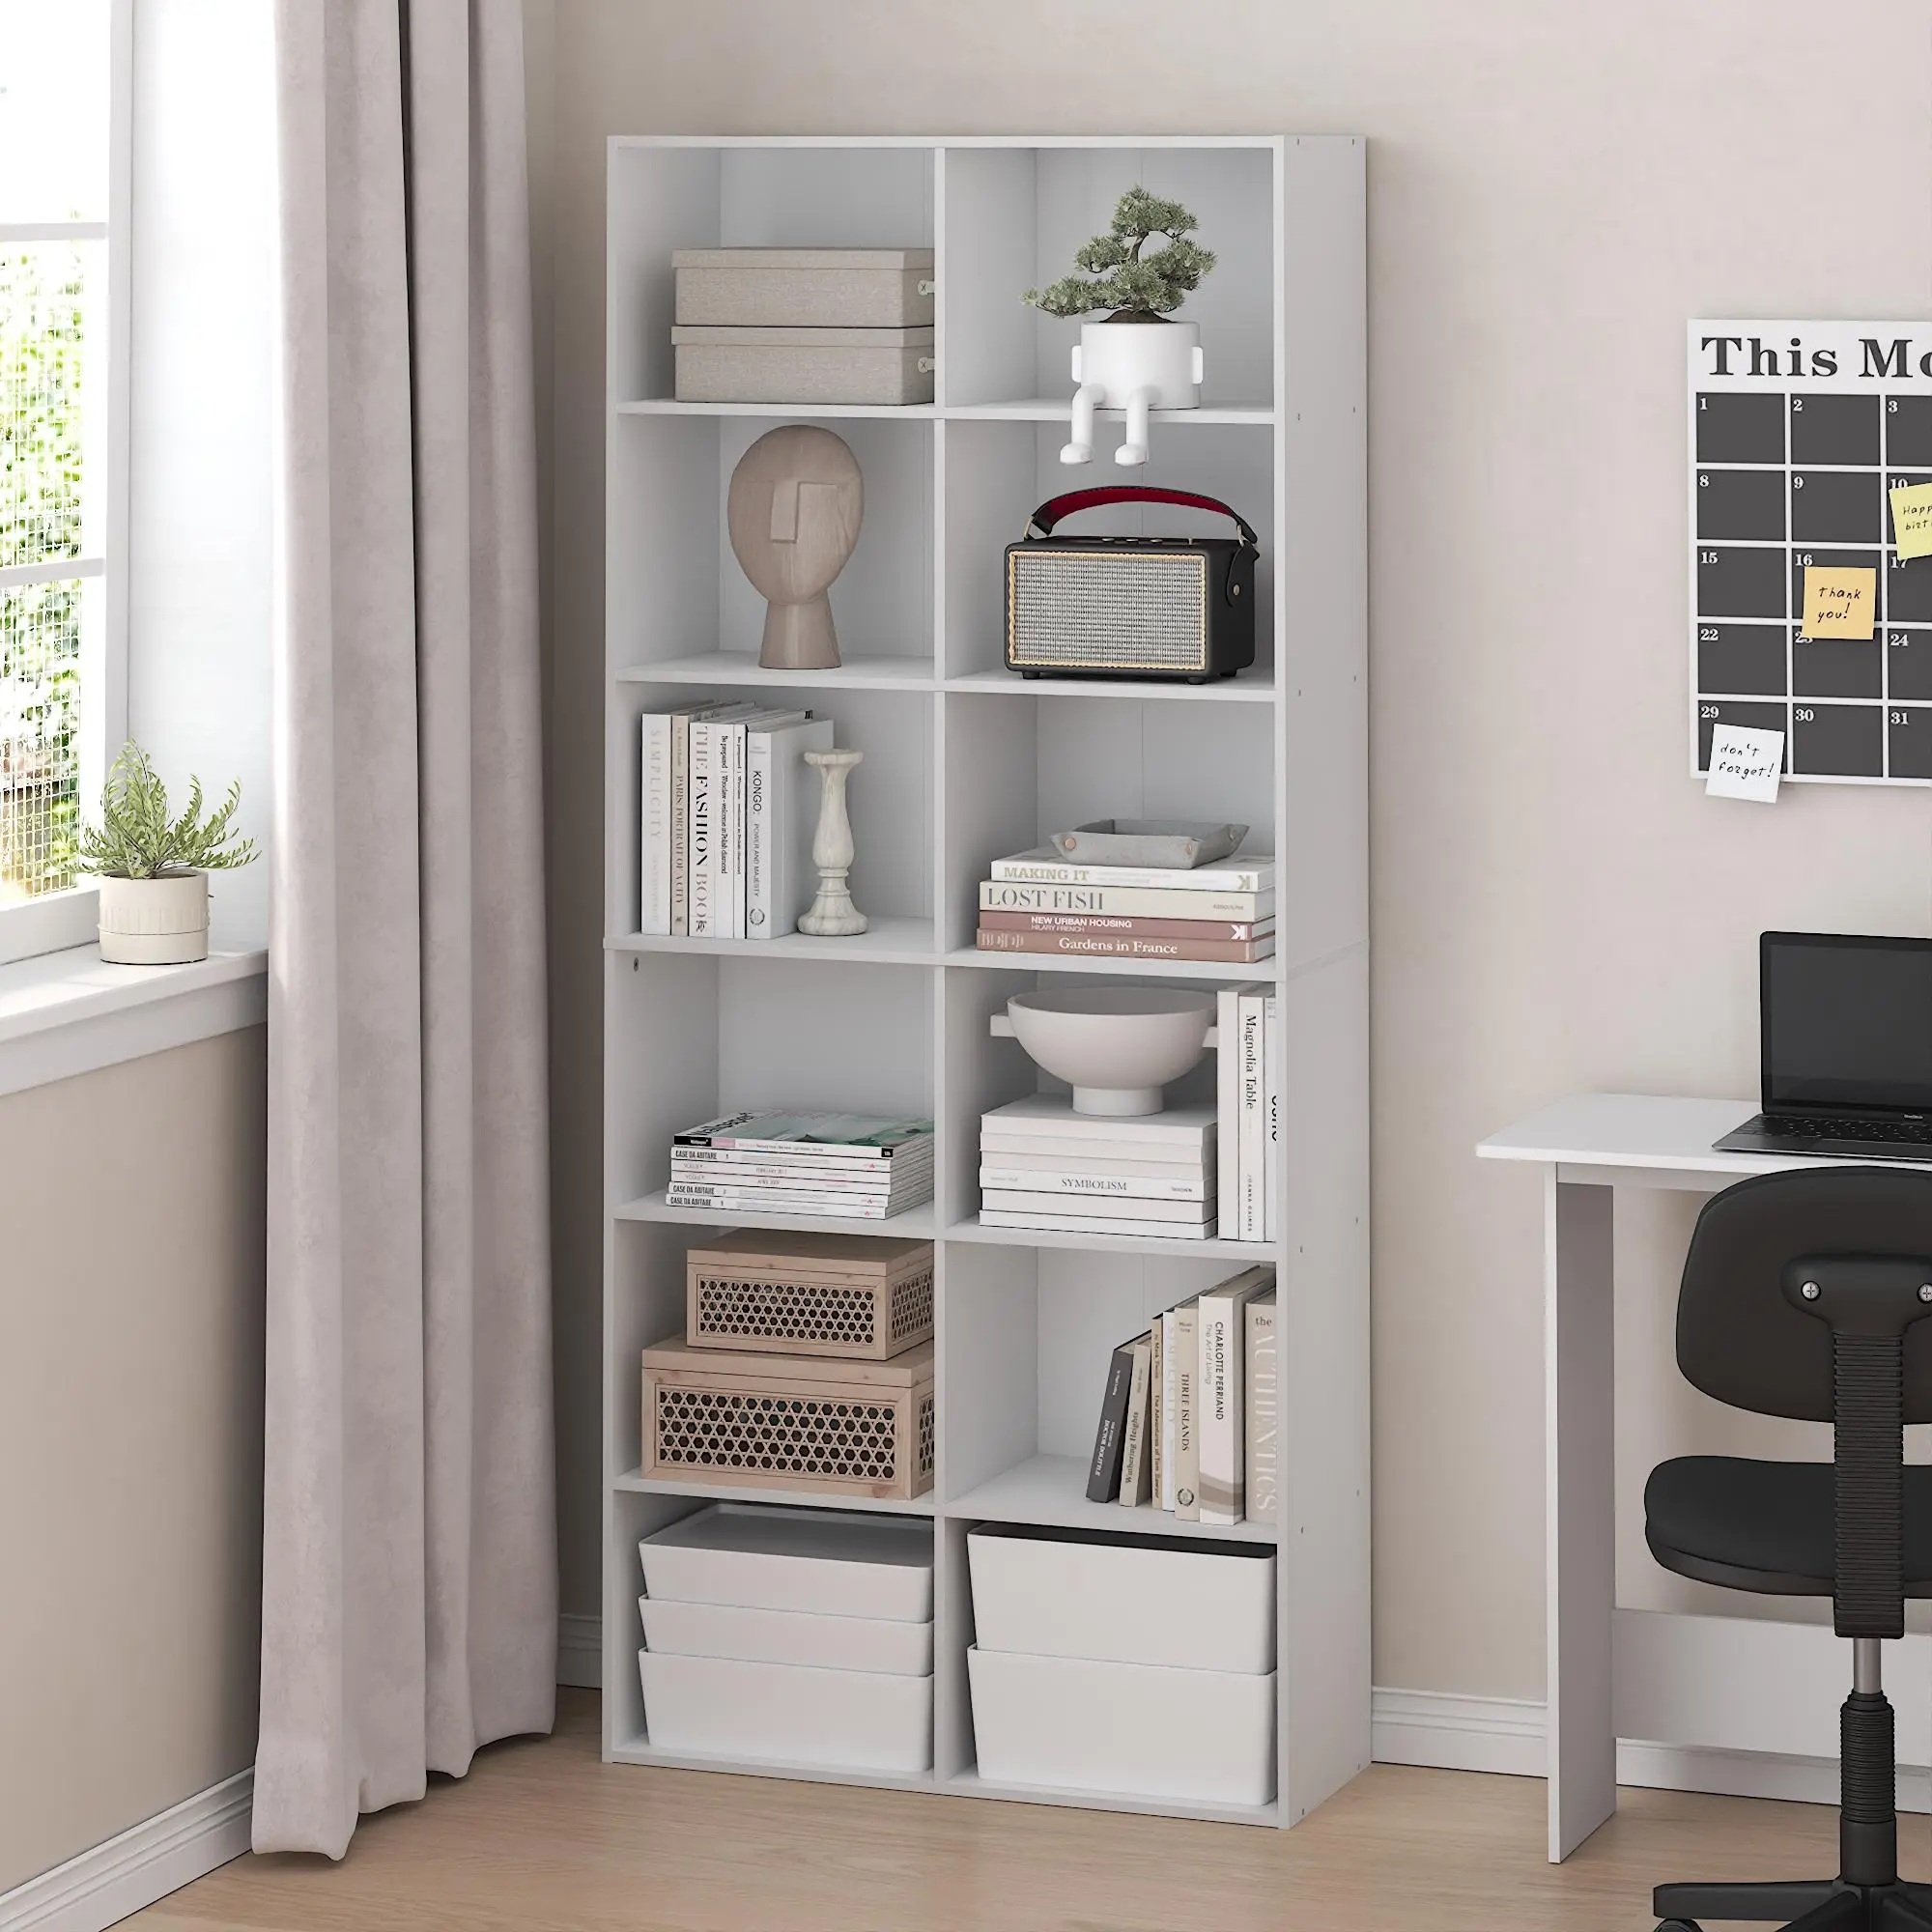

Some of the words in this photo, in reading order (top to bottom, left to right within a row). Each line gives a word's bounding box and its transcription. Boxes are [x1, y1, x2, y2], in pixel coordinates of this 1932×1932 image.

[1701, 337, 1838, 377] This
[1700, 398, 1708, 411] 1
[1793, 399, 1804, 412] 2
[1888, 401, 1898, 413] 3
[1699, 475, 1710, 488] 8
[1793, 476, 1804, 489] 9
[1890, 478, 1909, 489] 10
[1701, 552, 1719, 564] 15
[1795, 554, 1813, 566] 16
[1817, 602, 1850, 623] you!
[1700, 629, 1719, 641] 22
[1890, 634, 1909, 646] 24
[1701, 706, 1719, 719] 29
[1796, 709, 1814, 722] 30
[1890, 712, 1909, 724] 31
[696, 725, 708, 770] THE
[753, 770, 762, 815] KONGO:
[696, 776, 708, 867] FASHION
[1004, 867, 1069, 881] MAKING
[1072, 869, 1089, 882] IT
[987, 887, 1047, 909] LOST
[1053, 890, 1104, 911] FISH
[1031, 916, 1053, 925] NEW
[1054, 916, 1088, 926] URBAN
[1089, 918, 1132, 929] HOUSING
[1058, 937, 1113, 952] Gardens
[1116, 940, 1129, 952] in
[1132, 941, 1179, 954] France
[1243, 1014, 1257, 1072] Magnolia
[1245, 1076, 1257, 1110] Table
[1062, 1178, 1127, 1191] SYMBOLISM
[1255, 1316, 1272, 1326] the
[1215, 1321, 1224, 1373] CHARLOTTE
[1181, 1373, 1190, 1407] THREE
[1215, 1376, 1224, 1420] PERRIAND
[1181, 1408, 1190, 1452] ISLANDS
